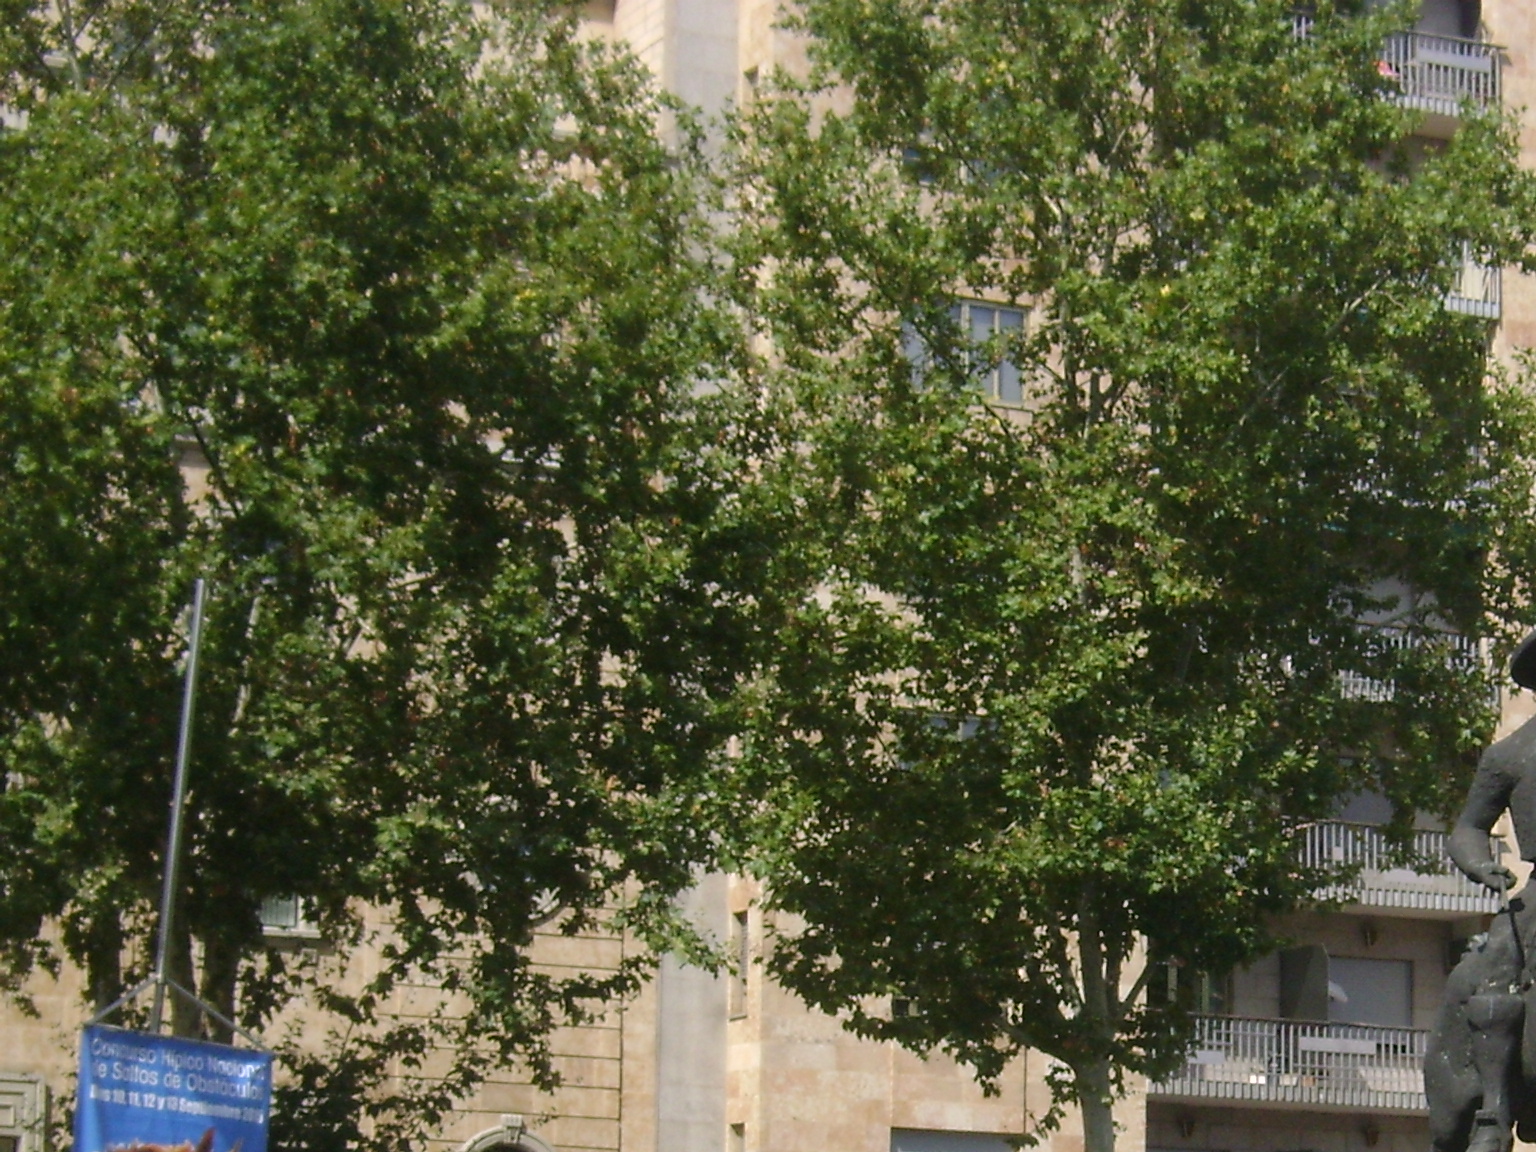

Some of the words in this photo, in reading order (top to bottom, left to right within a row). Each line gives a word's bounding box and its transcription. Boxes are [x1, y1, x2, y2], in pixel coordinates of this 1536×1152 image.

[91, 1038, 157, 1064] Concurso
[112, 1062, 158, 1086] Saltos
[163, 1071, 181, 1089] de
